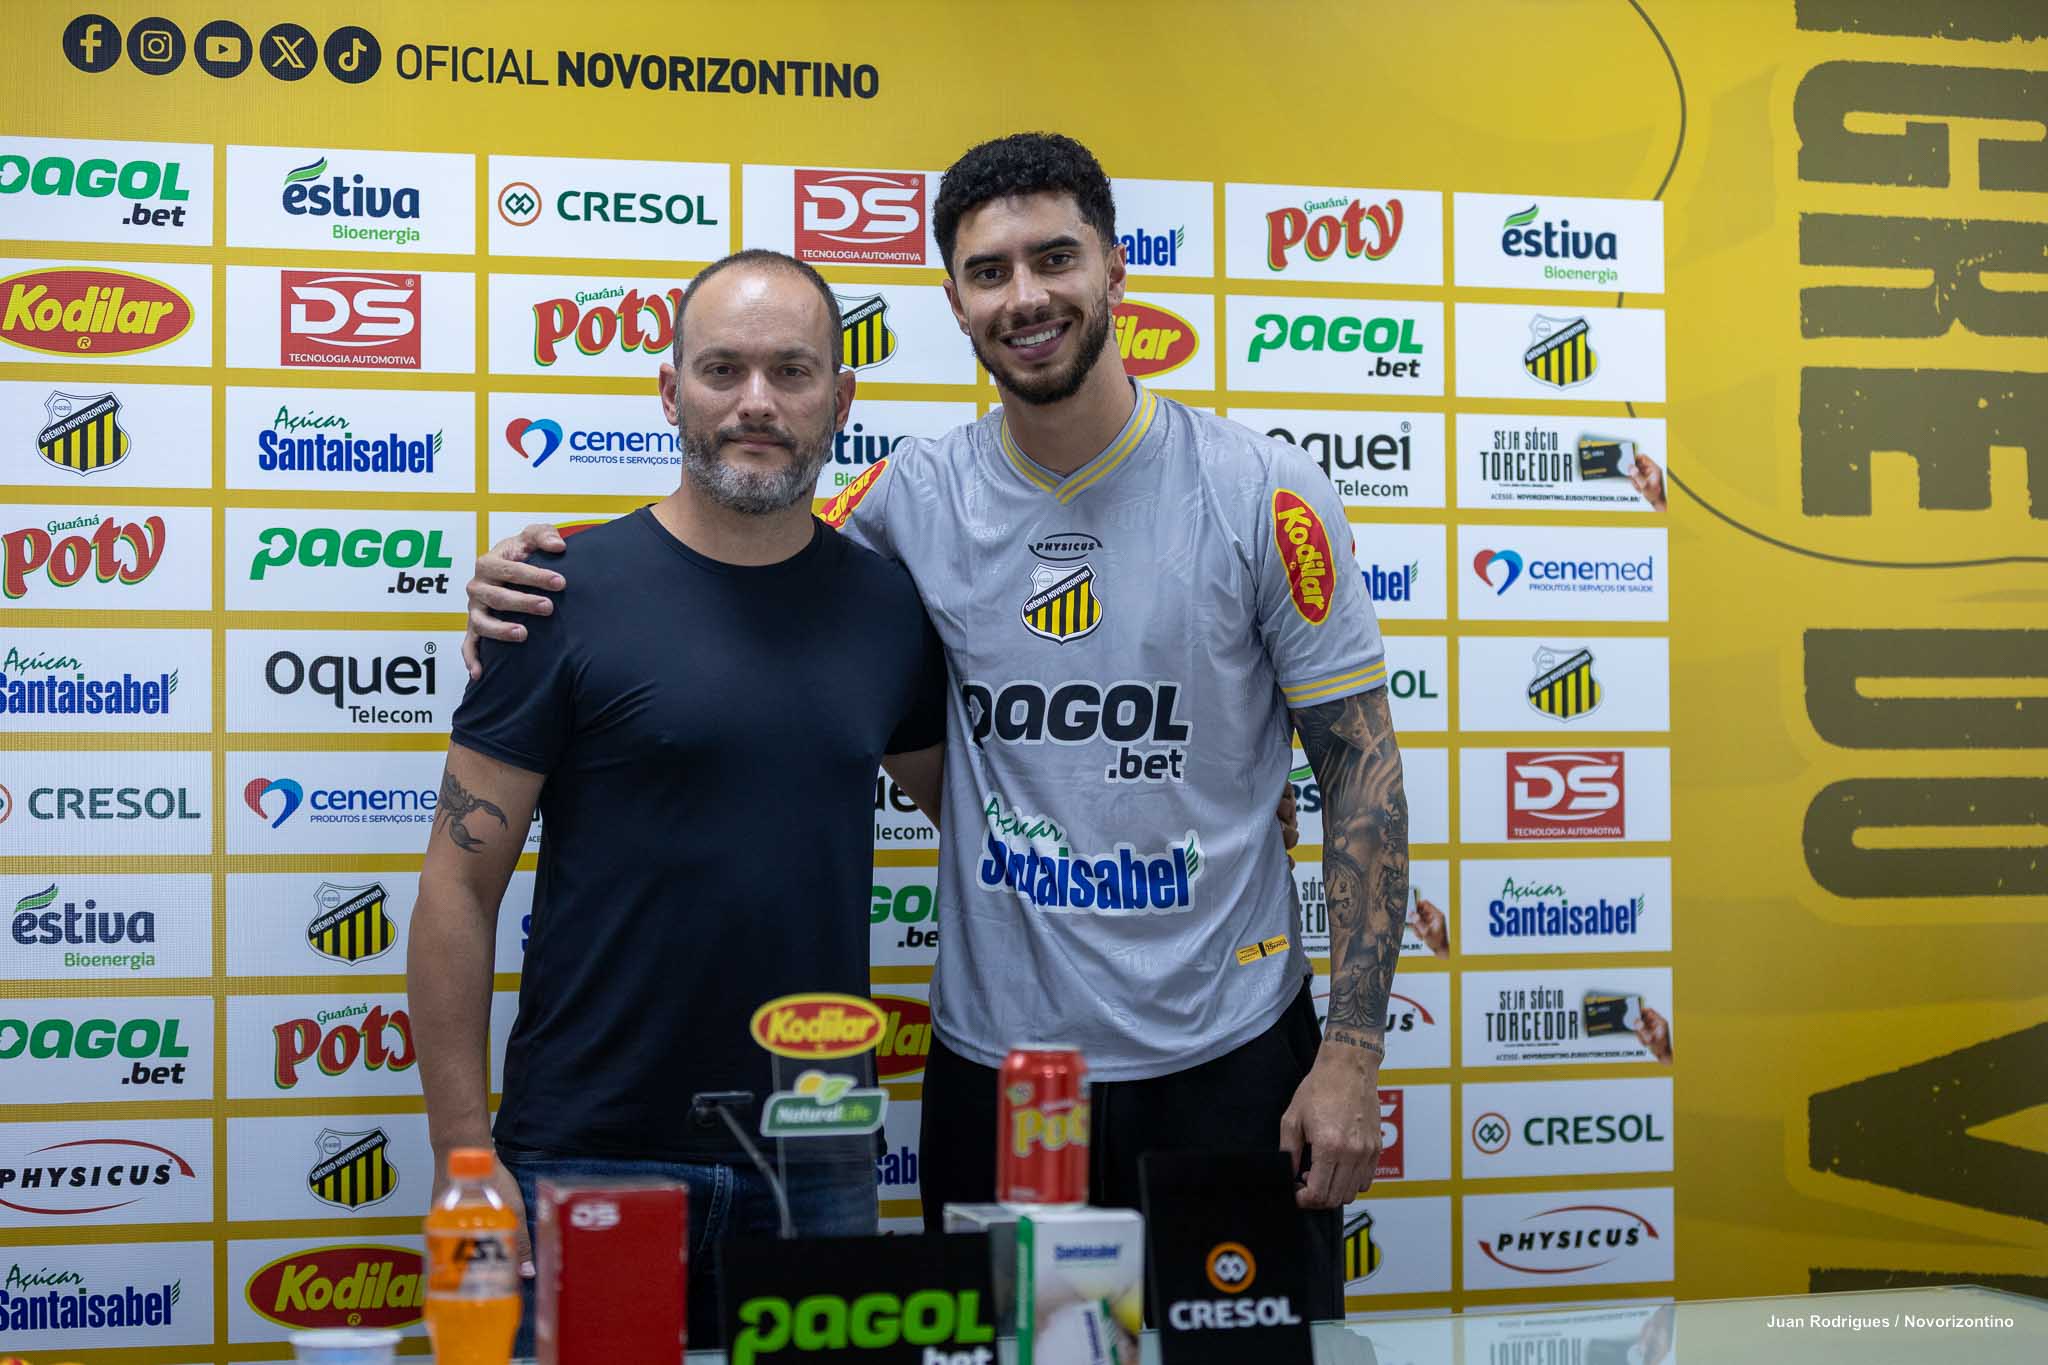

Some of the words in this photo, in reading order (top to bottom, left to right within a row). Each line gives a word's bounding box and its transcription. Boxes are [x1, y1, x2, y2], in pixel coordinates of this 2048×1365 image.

[396, 43, 548, 86] OFICIAL
[557, 51, 879, 99] NOVORIZONTINO
[281, 174, 420, 219] estiva
[557, 190, 718, 226] CRESOL
[803, 185, 919, 233] DS
[122, 203, 186, 227] .bet
[332, 224, 420, 245] Bioenergia
[1502, 220, 1617, 261] estiva
[802, 249, 861, 260] TECNOLOGIA
[861, 250, 922, 261] AUTOMOTIVA
[1544, 265, 1618, 284] Bioenergia
[2, 283, 174, 334] Kodilar
[290, 287, 415, 337] DS
[842, 300, 883, 329] OVORIZONTINO
[1115, 317, 1181, 361] ilar
[289, 354, 350, 364] TECNOLOGIA
[352, 354, 416, 365] AUTOMOTIVA
[1367, 357, 1420, 378] .bet
[65, 400, 115, 431] NOVORIZONTINO
[274, 405, 351, 431] Açúcar
[258, 429, 434, 474] Santaisabel
[570, 430, 682, 453] cenem
[1494, 430, 1520, 451] SEJA
[1525, 426, 1559, 451] SÓCIO
[570, 455, 618, 464] PRODUTOS
[620, 456, 625, 464] E
[626, 456, 669, 466] SERVIÇOS
[1480, 452, 1573, 483] TORCEDOR
[1335, 480, 1408, 497] Telecom
[1036, 542, 1096, 551] PHYSICUS
[1277, 506, 1326, 610] Kodilar
[1529, 555, 1653, 581] cenemed
[387, 571, 448, 595] .bet
[1046, 570, 1090, 600] NOVORIZONTINO
[1529, 583, 1569, 592] PRODUTOS
[4, 646, 82, 673] Açúcar
[265, 650, 436, 709] Oquei
[349, 706, 433, 724] Telecom
[1108, 747, 1183, 780] .bet
[310, 789, 437, 810] ceneme
[1514, 765, 1619, 811] DS
[28, 787, 200, 820] CRESOL
[310, 814, 360, 823] PRODUTOS
[362, 814, 367, 823] E
[369, 814, 413, 825] SERVIÇOS
[414, 814, 425, 823] DE
[876, 822, 934, 841] lecom
[1514, 826, 1564, 836] TECNOLOGIA
[1567, 825, 1621, 836] AUTOMOTIVA
[1502, 878, 1565, 901] Açúcar
[334, 889, 382, 920] NOVORIZONTINO
[12, 899, 155, 944] estiva
[1489, 898, 1637, 938] Santaisabel
[64, 951, 155, 970] Bioenergia
[1500, 990, 1525, 1010] SEJA
[1531, 985, 1564, 1009] SÓCIO
[768, 1008, 876, 1044] Kodilar
[1485, 1010, 1578, 1043] TORCEDOR
[122, 1062, 185, 1085] .bet
[1524, 1114, 1664, 1146] CRESOL
[0, 1164, 171, 1189] PHYSICUS
[1497, 1227, 1639, 1252] PHYSICUS
[6, 1263, 84, 1289] Açúcar
[1170, 1298, 1299, 1331] CRESOL
